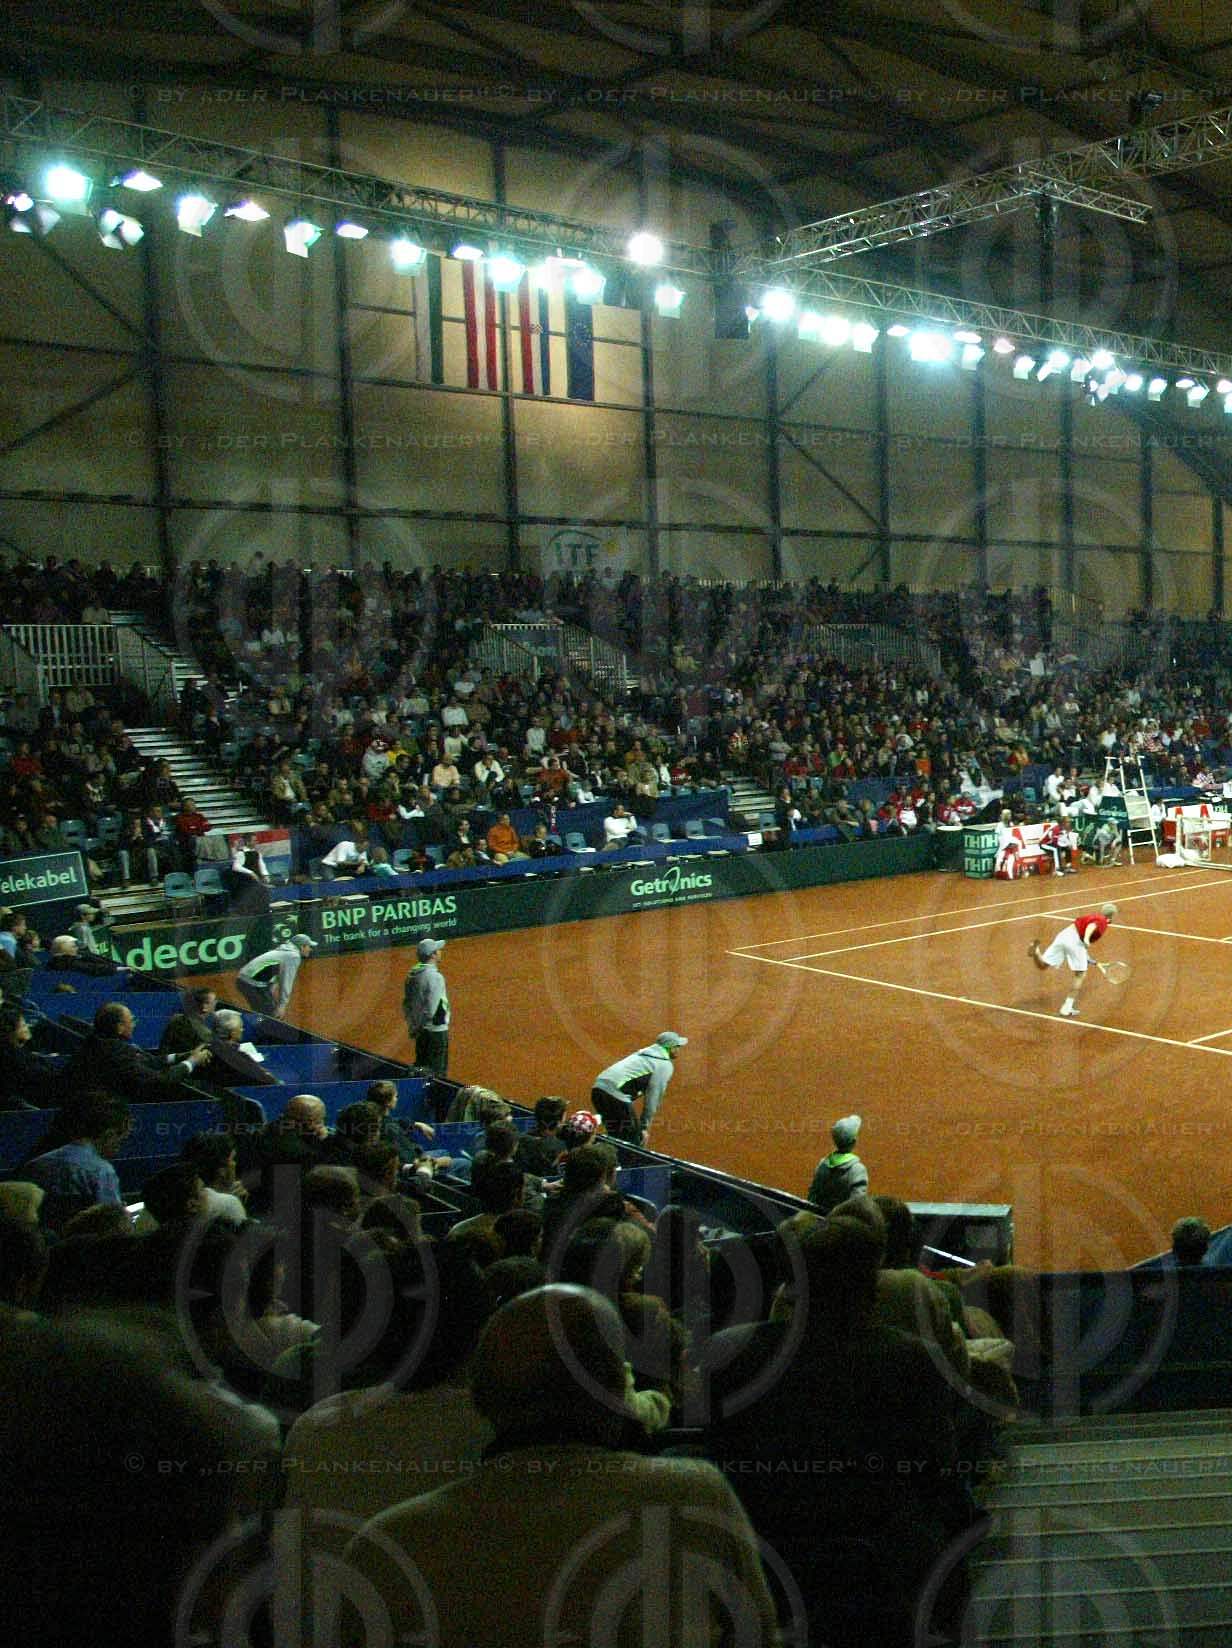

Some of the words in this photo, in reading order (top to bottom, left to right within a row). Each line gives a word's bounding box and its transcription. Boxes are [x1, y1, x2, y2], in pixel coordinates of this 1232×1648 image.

[0, 866, 78, 895] elekabel
[321, 907, 366, 930] BNP
[371, 895, 457, 923] PARIBAS
